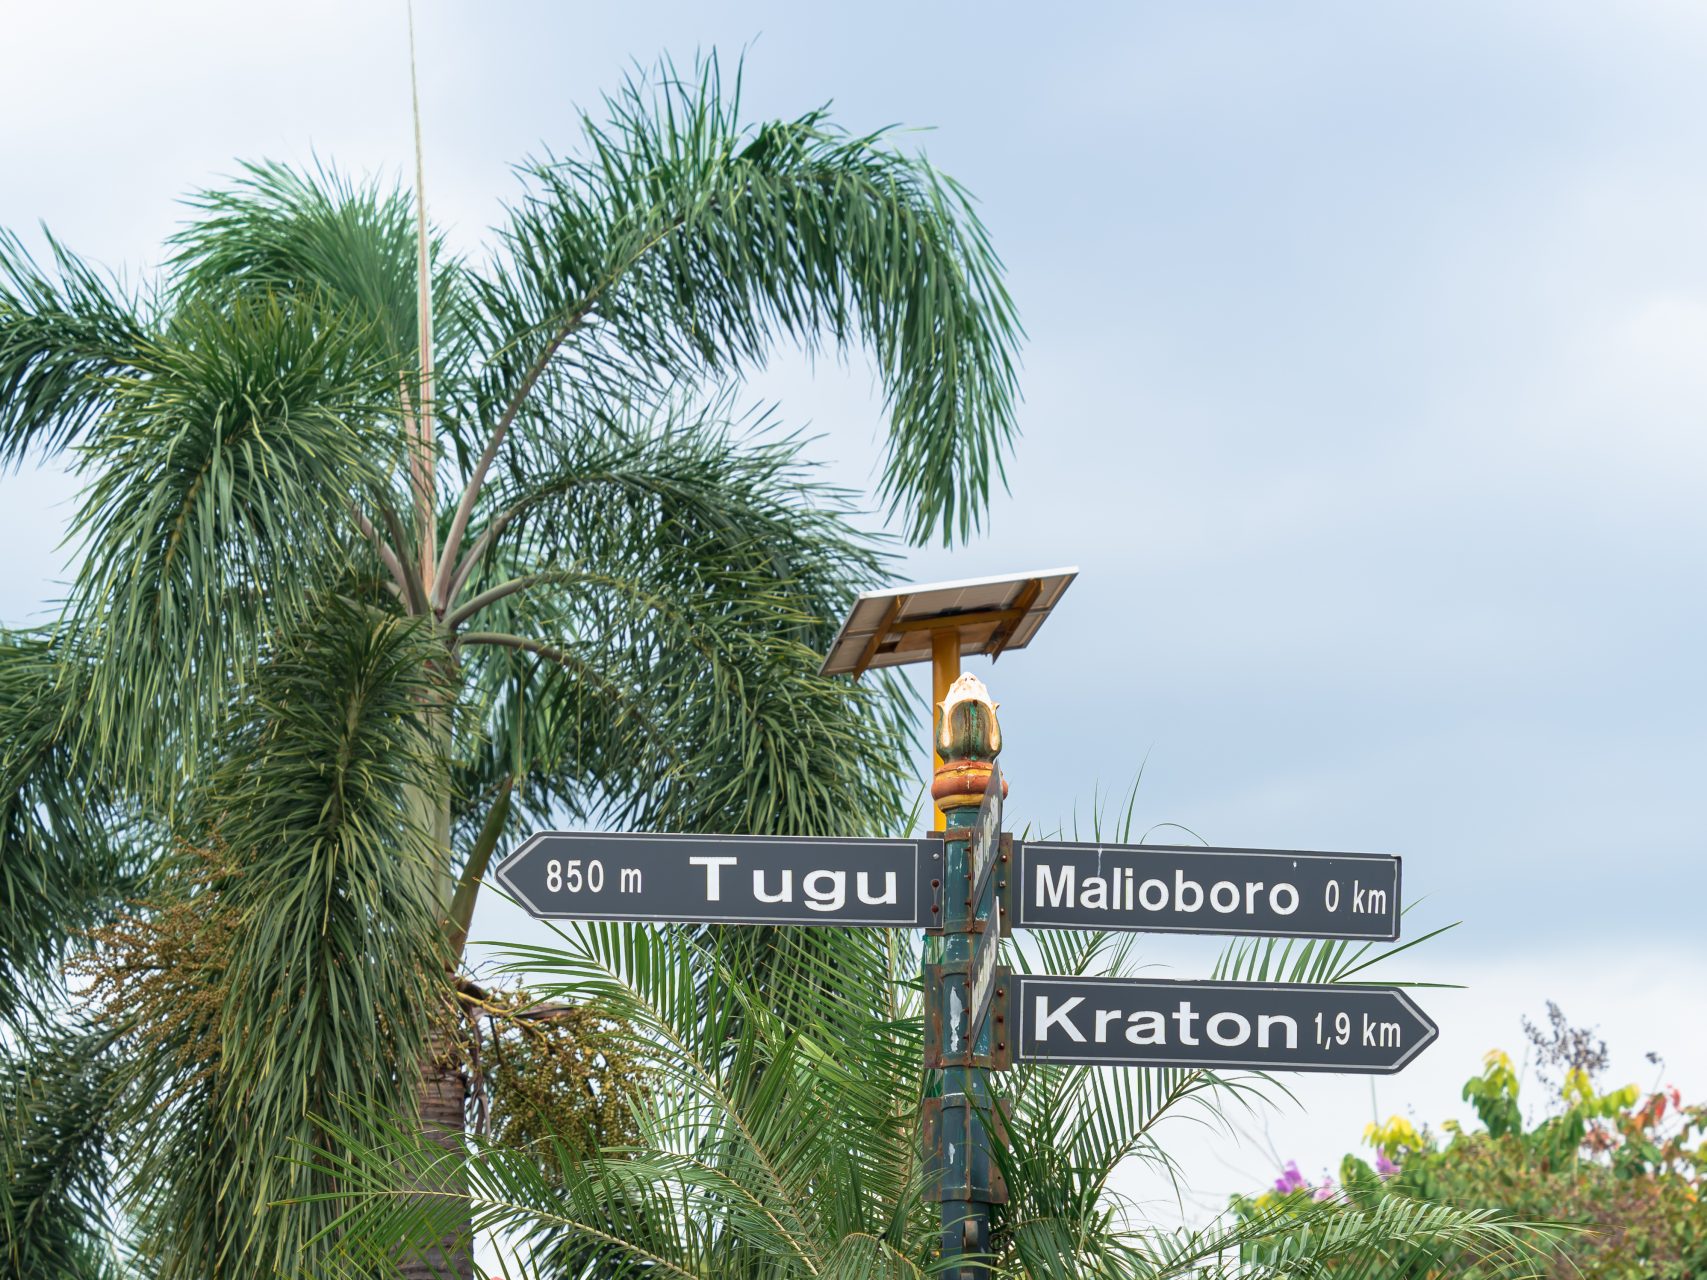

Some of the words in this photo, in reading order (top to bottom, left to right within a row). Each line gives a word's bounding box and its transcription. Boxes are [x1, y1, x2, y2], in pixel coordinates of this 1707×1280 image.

[546, 859, 604, 893] 850
[620, 868, 642, 894] m
[689, 856, 897, 912] Tugu
[1035, 864, 1300, 916] Malioboro
[1325, 879, 1340, 913] 0
[1352, 879, 1387, 915] km
[1035, 995, 1298, 1049] Kraton
[1314, 1012, 1351, 1050] 1,9
[1362, 1012, 1401, 1048] km
